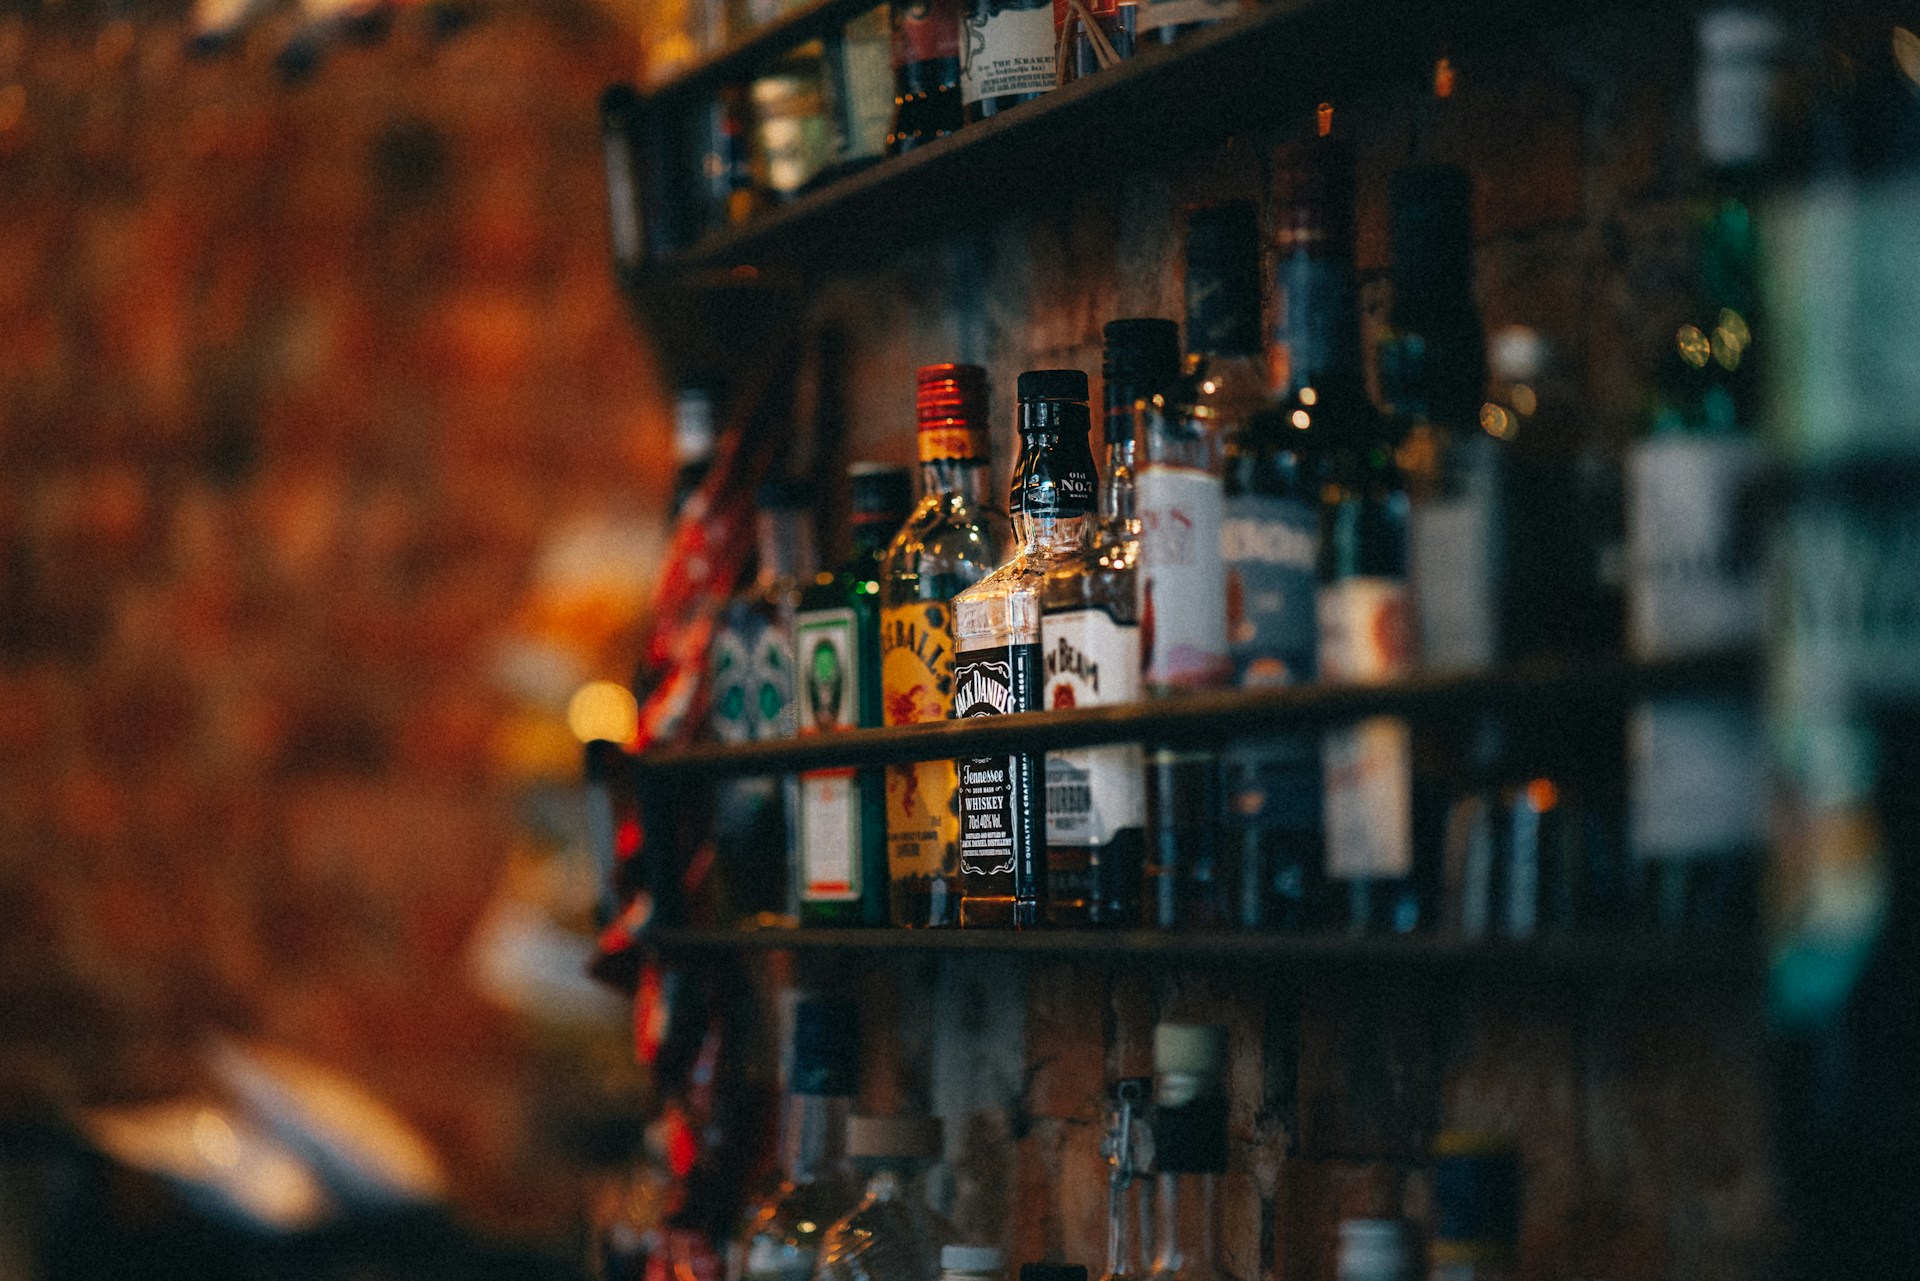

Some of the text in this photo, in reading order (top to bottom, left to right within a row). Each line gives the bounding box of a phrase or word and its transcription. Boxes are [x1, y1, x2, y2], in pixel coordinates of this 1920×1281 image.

[963, 765, 1004, 785] Tennessee
[965, 796, 1004, 811] WHISKEY
[1024, 818, 1032, 859] QUALITY
